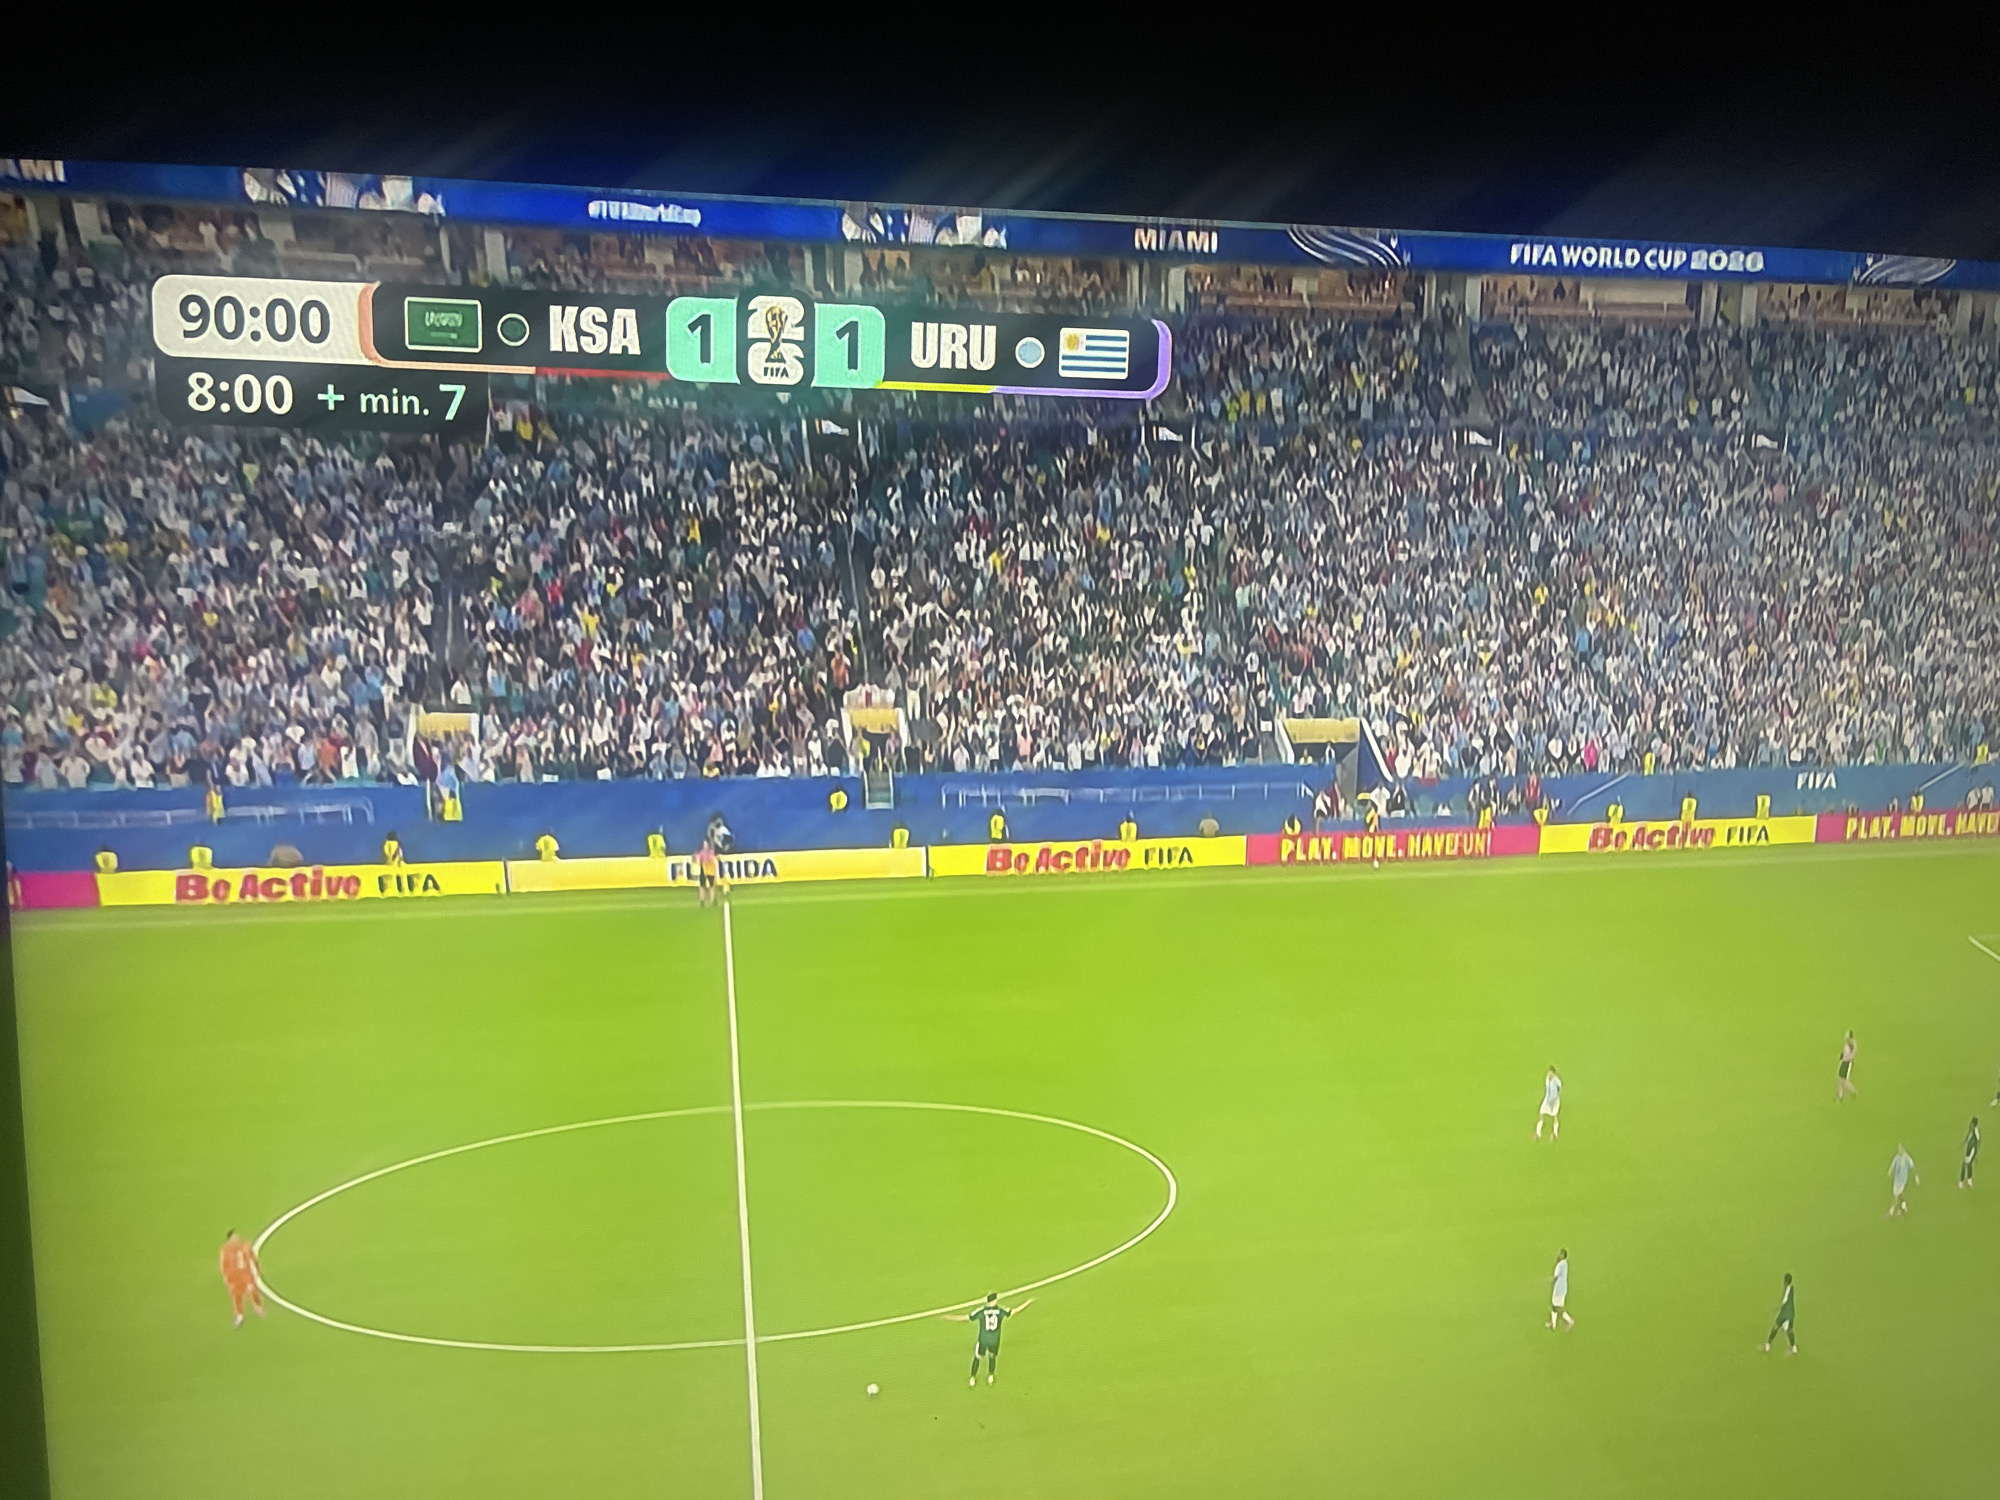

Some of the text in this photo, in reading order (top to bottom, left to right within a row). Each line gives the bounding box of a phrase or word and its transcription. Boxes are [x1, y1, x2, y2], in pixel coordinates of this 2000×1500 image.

[1134, 227, 1219, 253] MIAMI
[1510, 242, 1557, 267] FIFA
[1561, 244, 1640, 270] WORLD
[1644, 247, 1687, 271] CUP
[179, 294, 331, 344] 90:00
[549, 304, 641, 355] KSA
[687, 313, 712, 365] 1
[835, 320, 859, 371] 1
[910, 321, 997, 371] URU
[763, 366, 790, 379] FIFA
[187, 371, 293, 415] 8:00
[360, 387, 430, 416] min.
[438, 383, 467, 421] 7
[1796, 772, 1837, 791] FIFA
[1727, 825, 1769, 844] FIFA
[1144, 846, 1193, 865] FIFA
[670, 857, 778, 882] FLRIDA
[377, 873, 441, 896] FIFA
